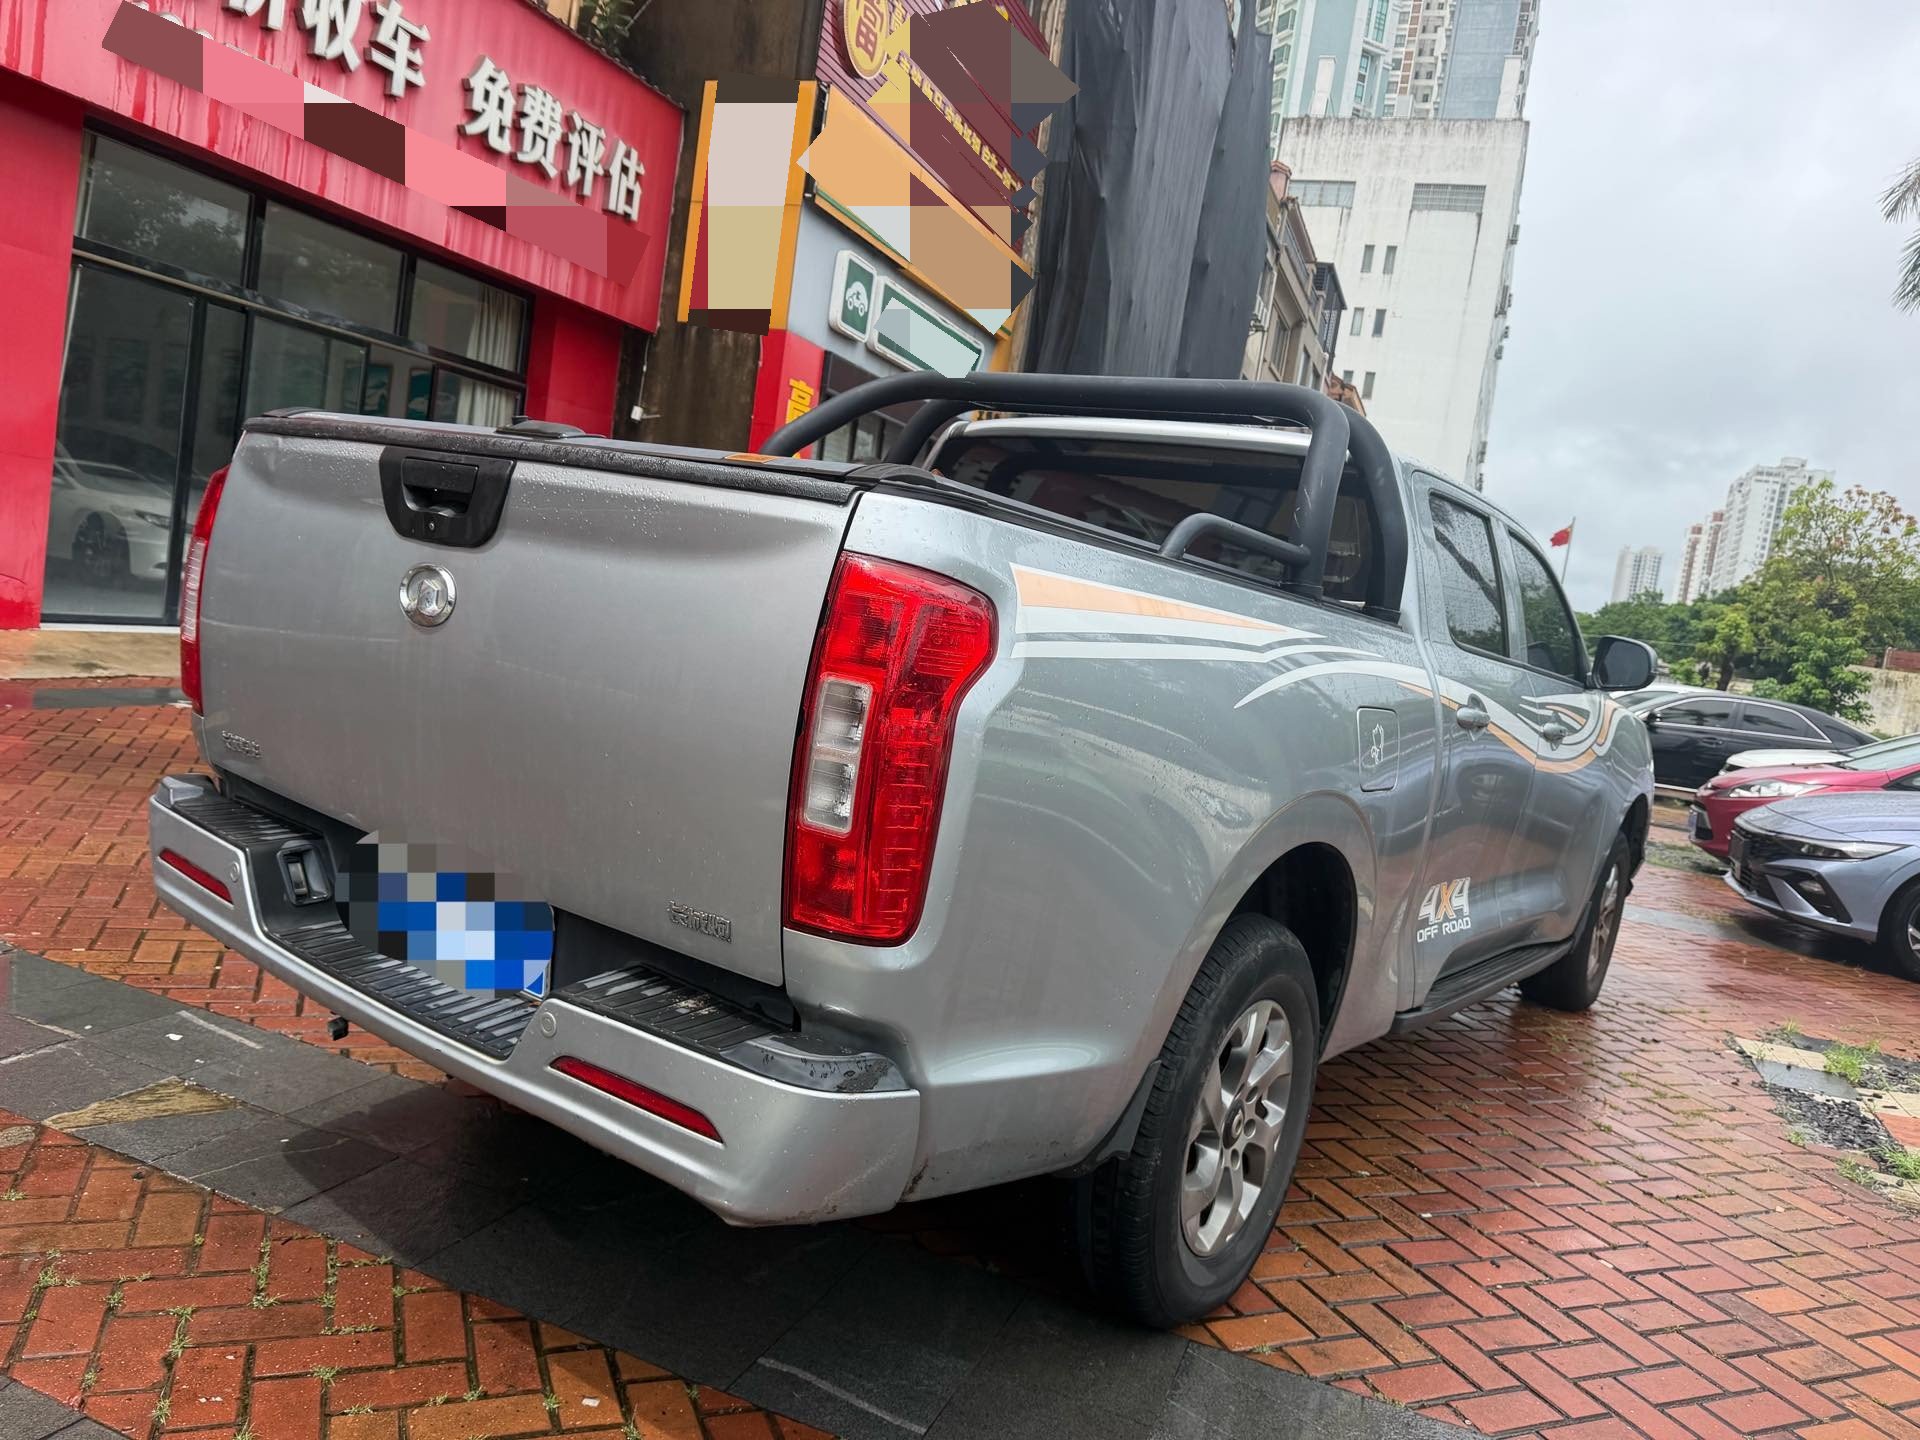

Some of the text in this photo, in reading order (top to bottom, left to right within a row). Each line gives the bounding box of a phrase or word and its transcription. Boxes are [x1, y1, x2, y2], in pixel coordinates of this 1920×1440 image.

[457, 55, 645, 222] 免费评估
[1418, 877, 1471, 925] 4X4
[1416, 917, 1472, 943] OFF ROAD
